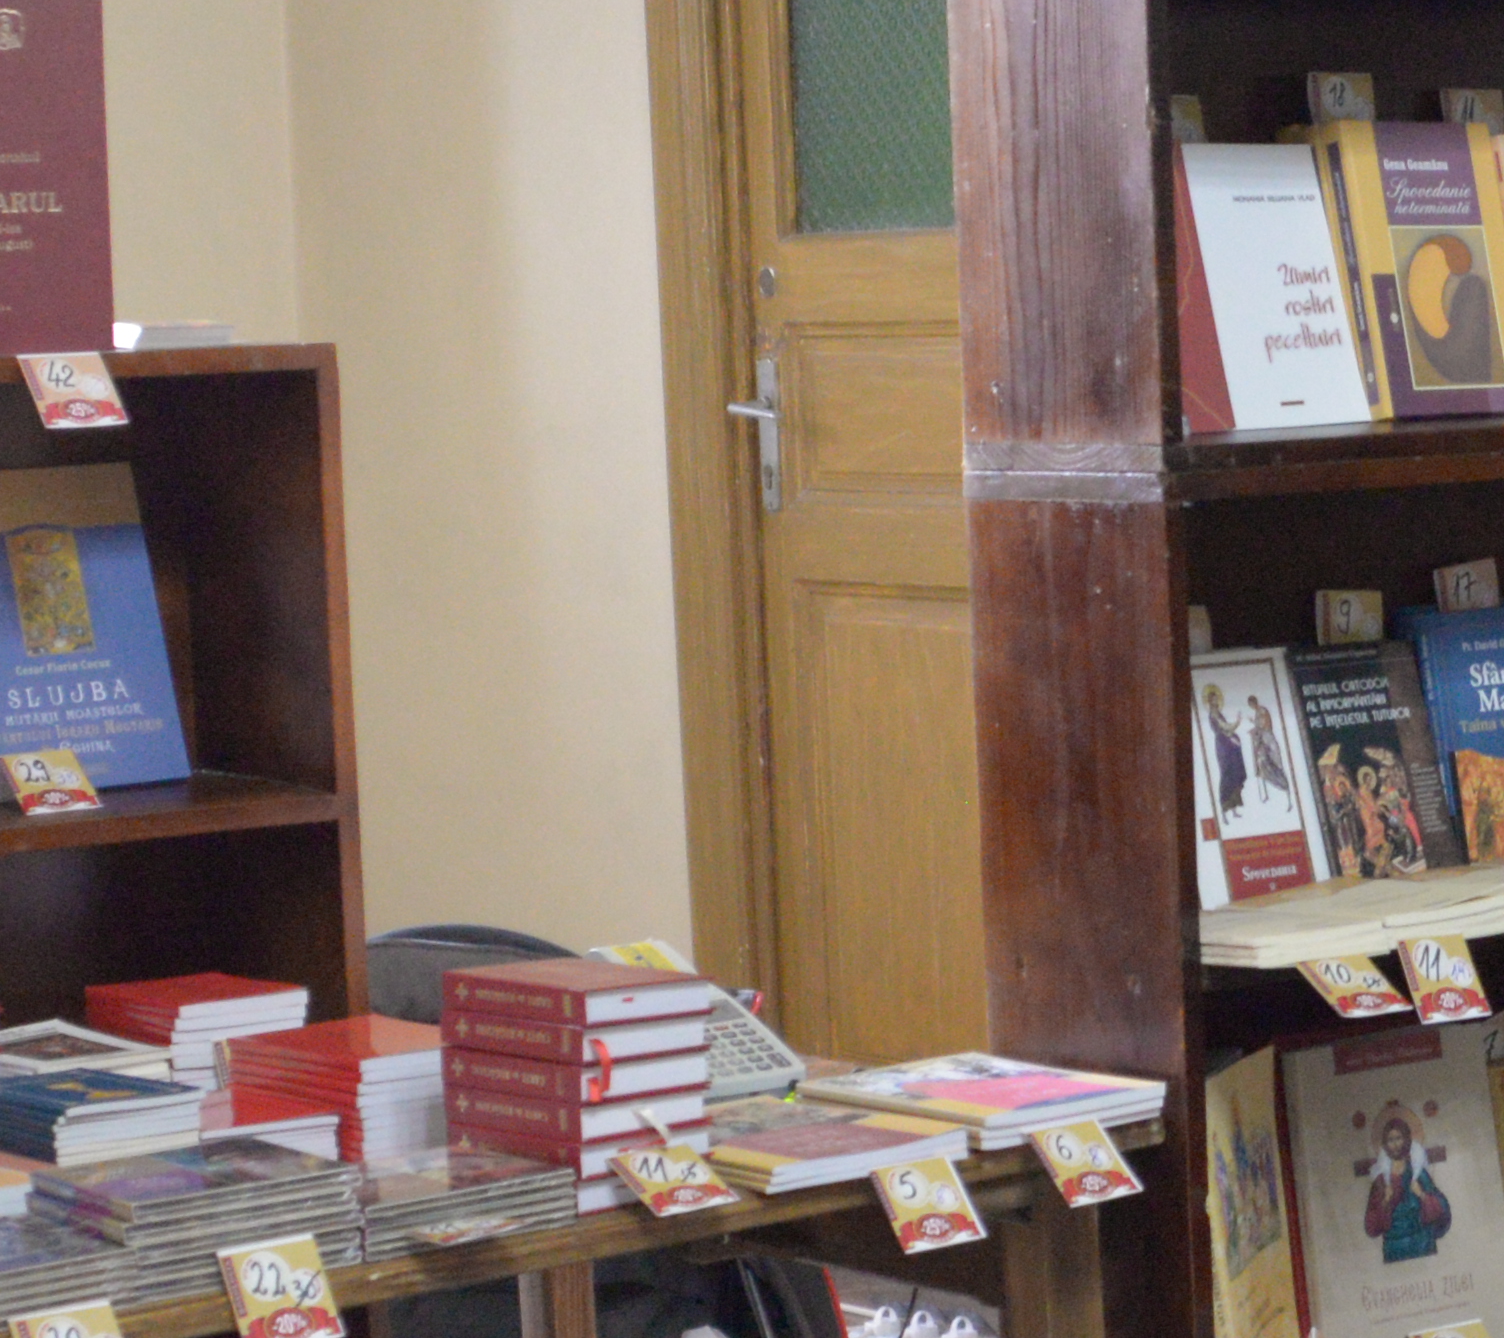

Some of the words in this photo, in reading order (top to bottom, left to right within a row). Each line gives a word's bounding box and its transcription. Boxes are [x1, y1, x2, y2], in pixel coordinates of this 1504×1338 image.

[1386, 176, 1473, 200] Spovedanie
[47, 361, 77, 390] 42
[1337, 599, 1353, 634] 9
[7, 678, 130, 710] SLUJBA
[19, 759, 51, 784] 29
[1322, 962, 1352, 986] 10
[1418, 946, 1442, 982] 11
[1055, 1133, 1073, 1160] 6
[898, 1169, 917, 1201] 5
[250, 1260, 287, 1297] 22
[269, 1312, 310, 1337] -20%
